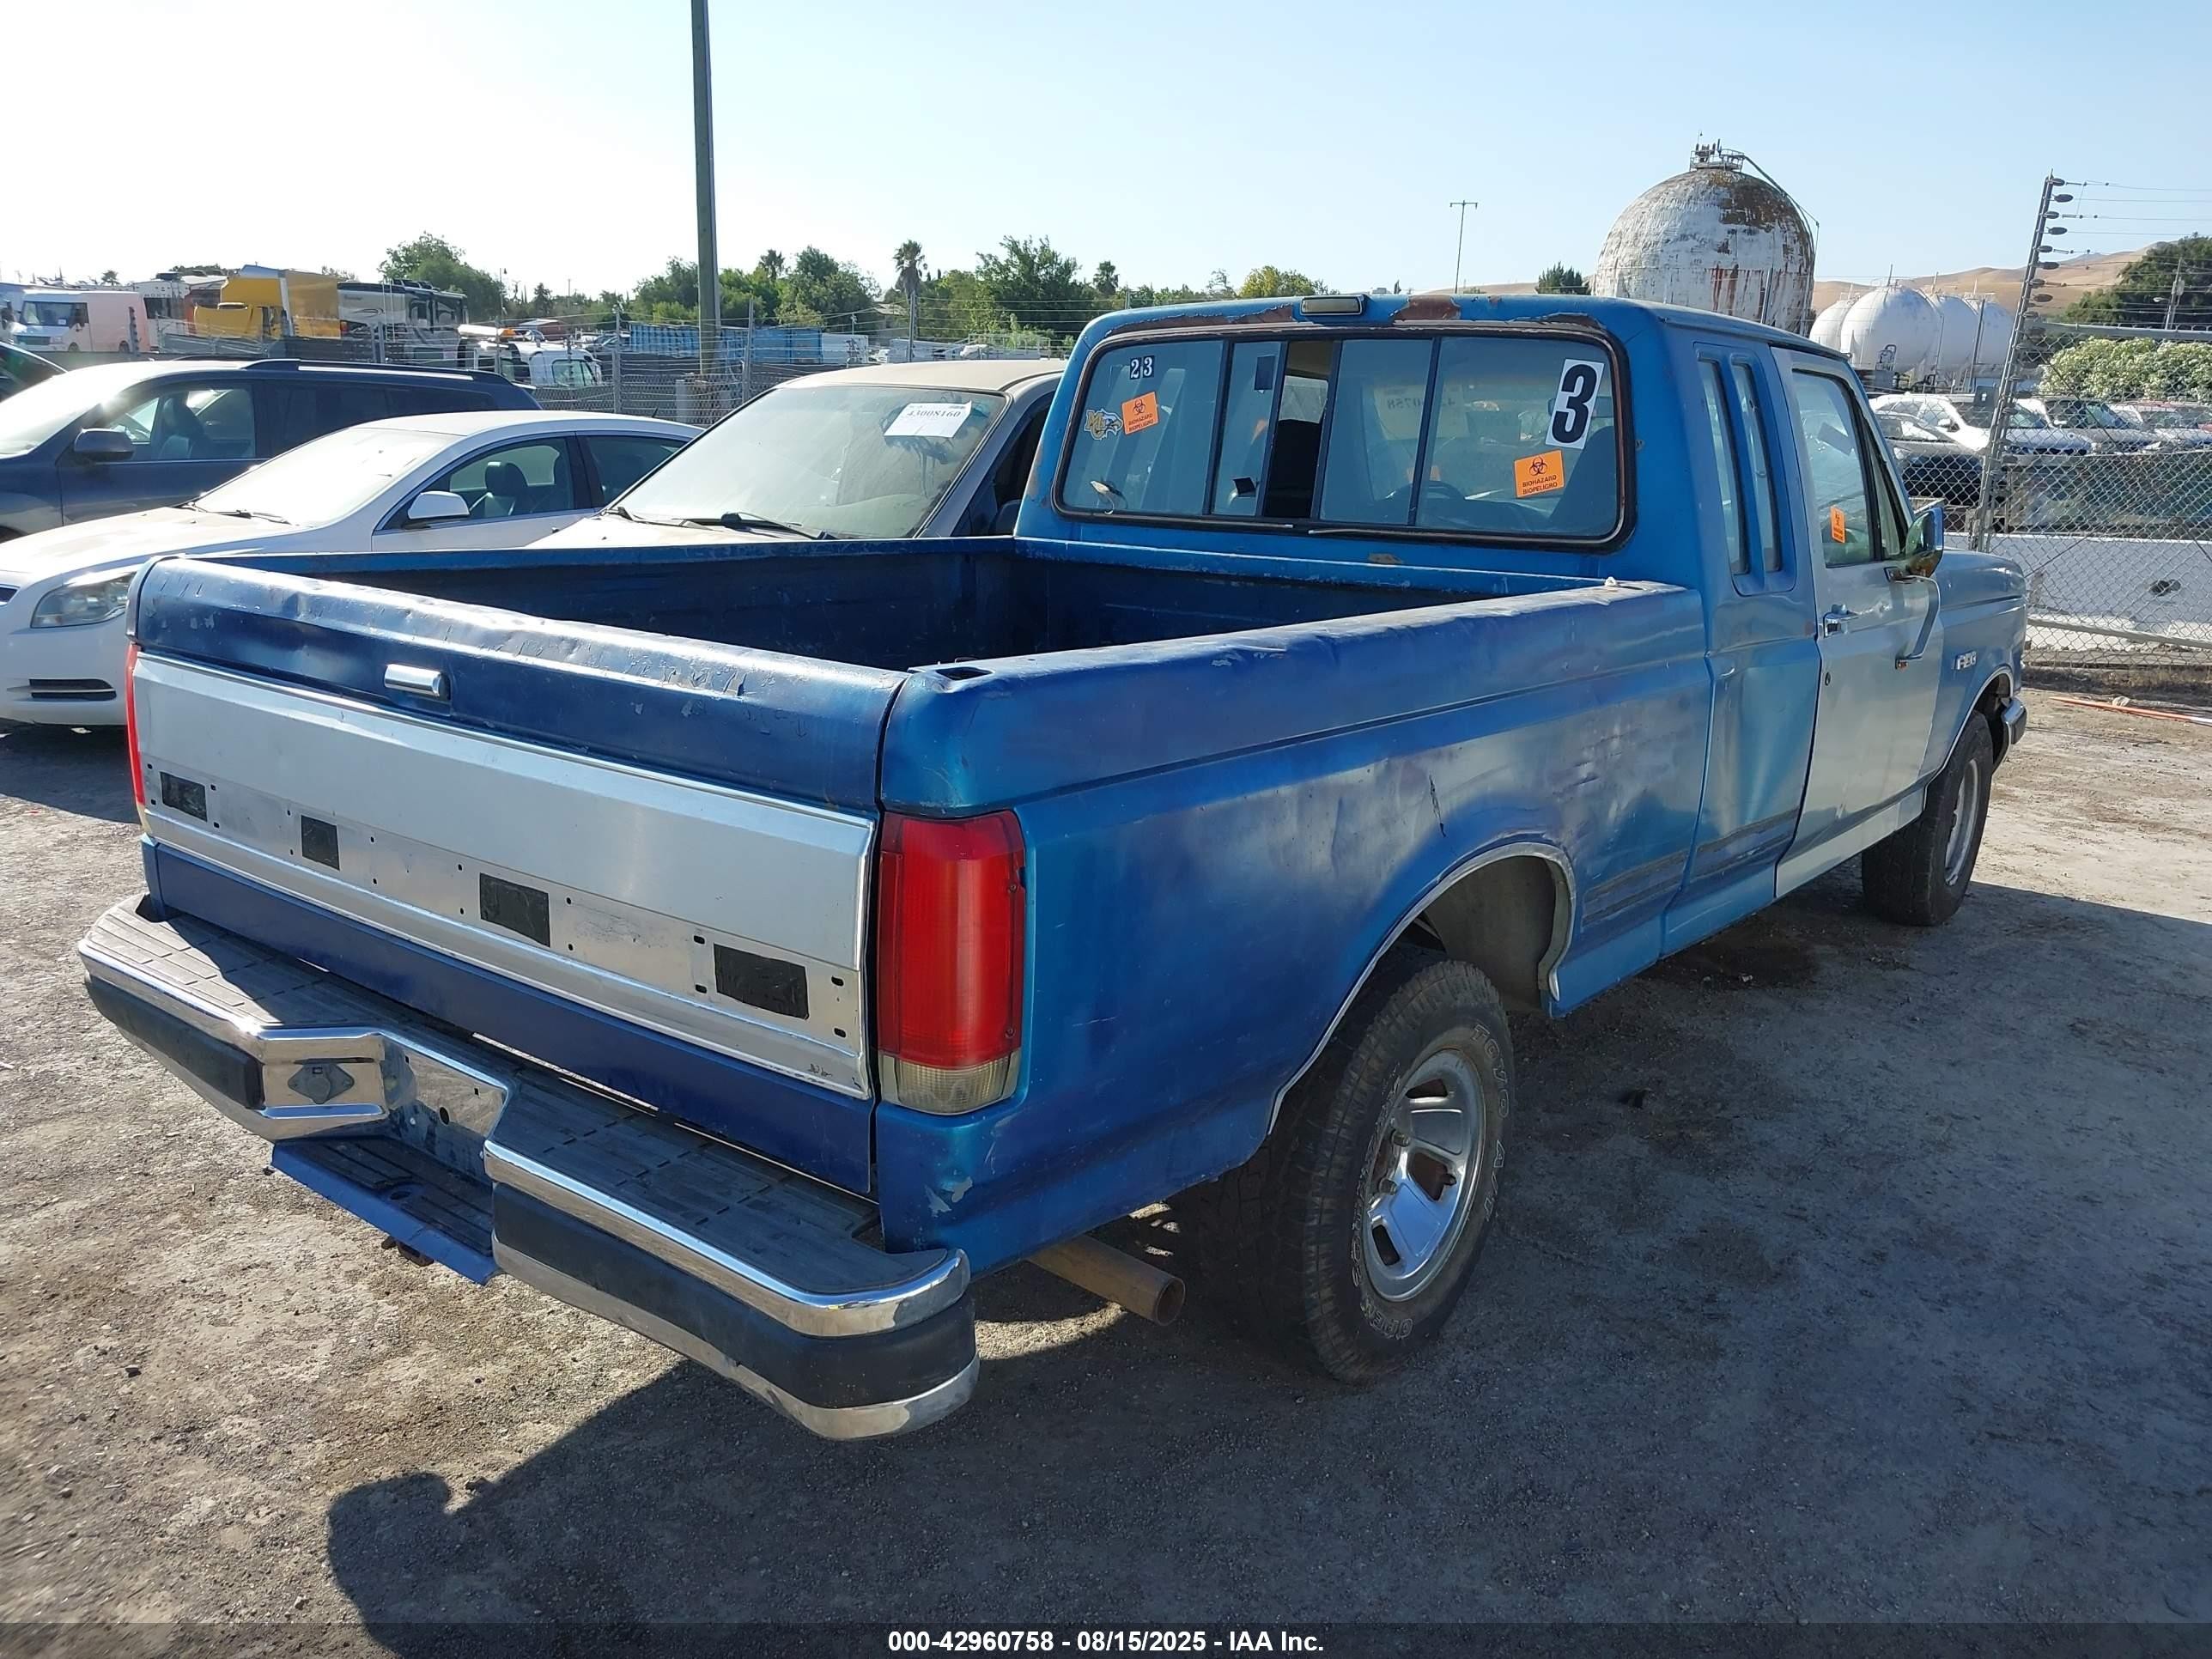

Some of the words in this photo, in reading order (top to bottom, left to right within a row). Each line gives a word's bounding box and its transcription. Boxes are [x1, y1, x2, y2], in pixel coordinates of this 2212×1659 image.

[1552, 364, 1597, 443] 3
[1522, 475, 1557, 488] BIOHAZARD
[1522, 482, 1558, 495] BIOPELIGRO
[1470, 1024, 1510, 1118] TOYO
